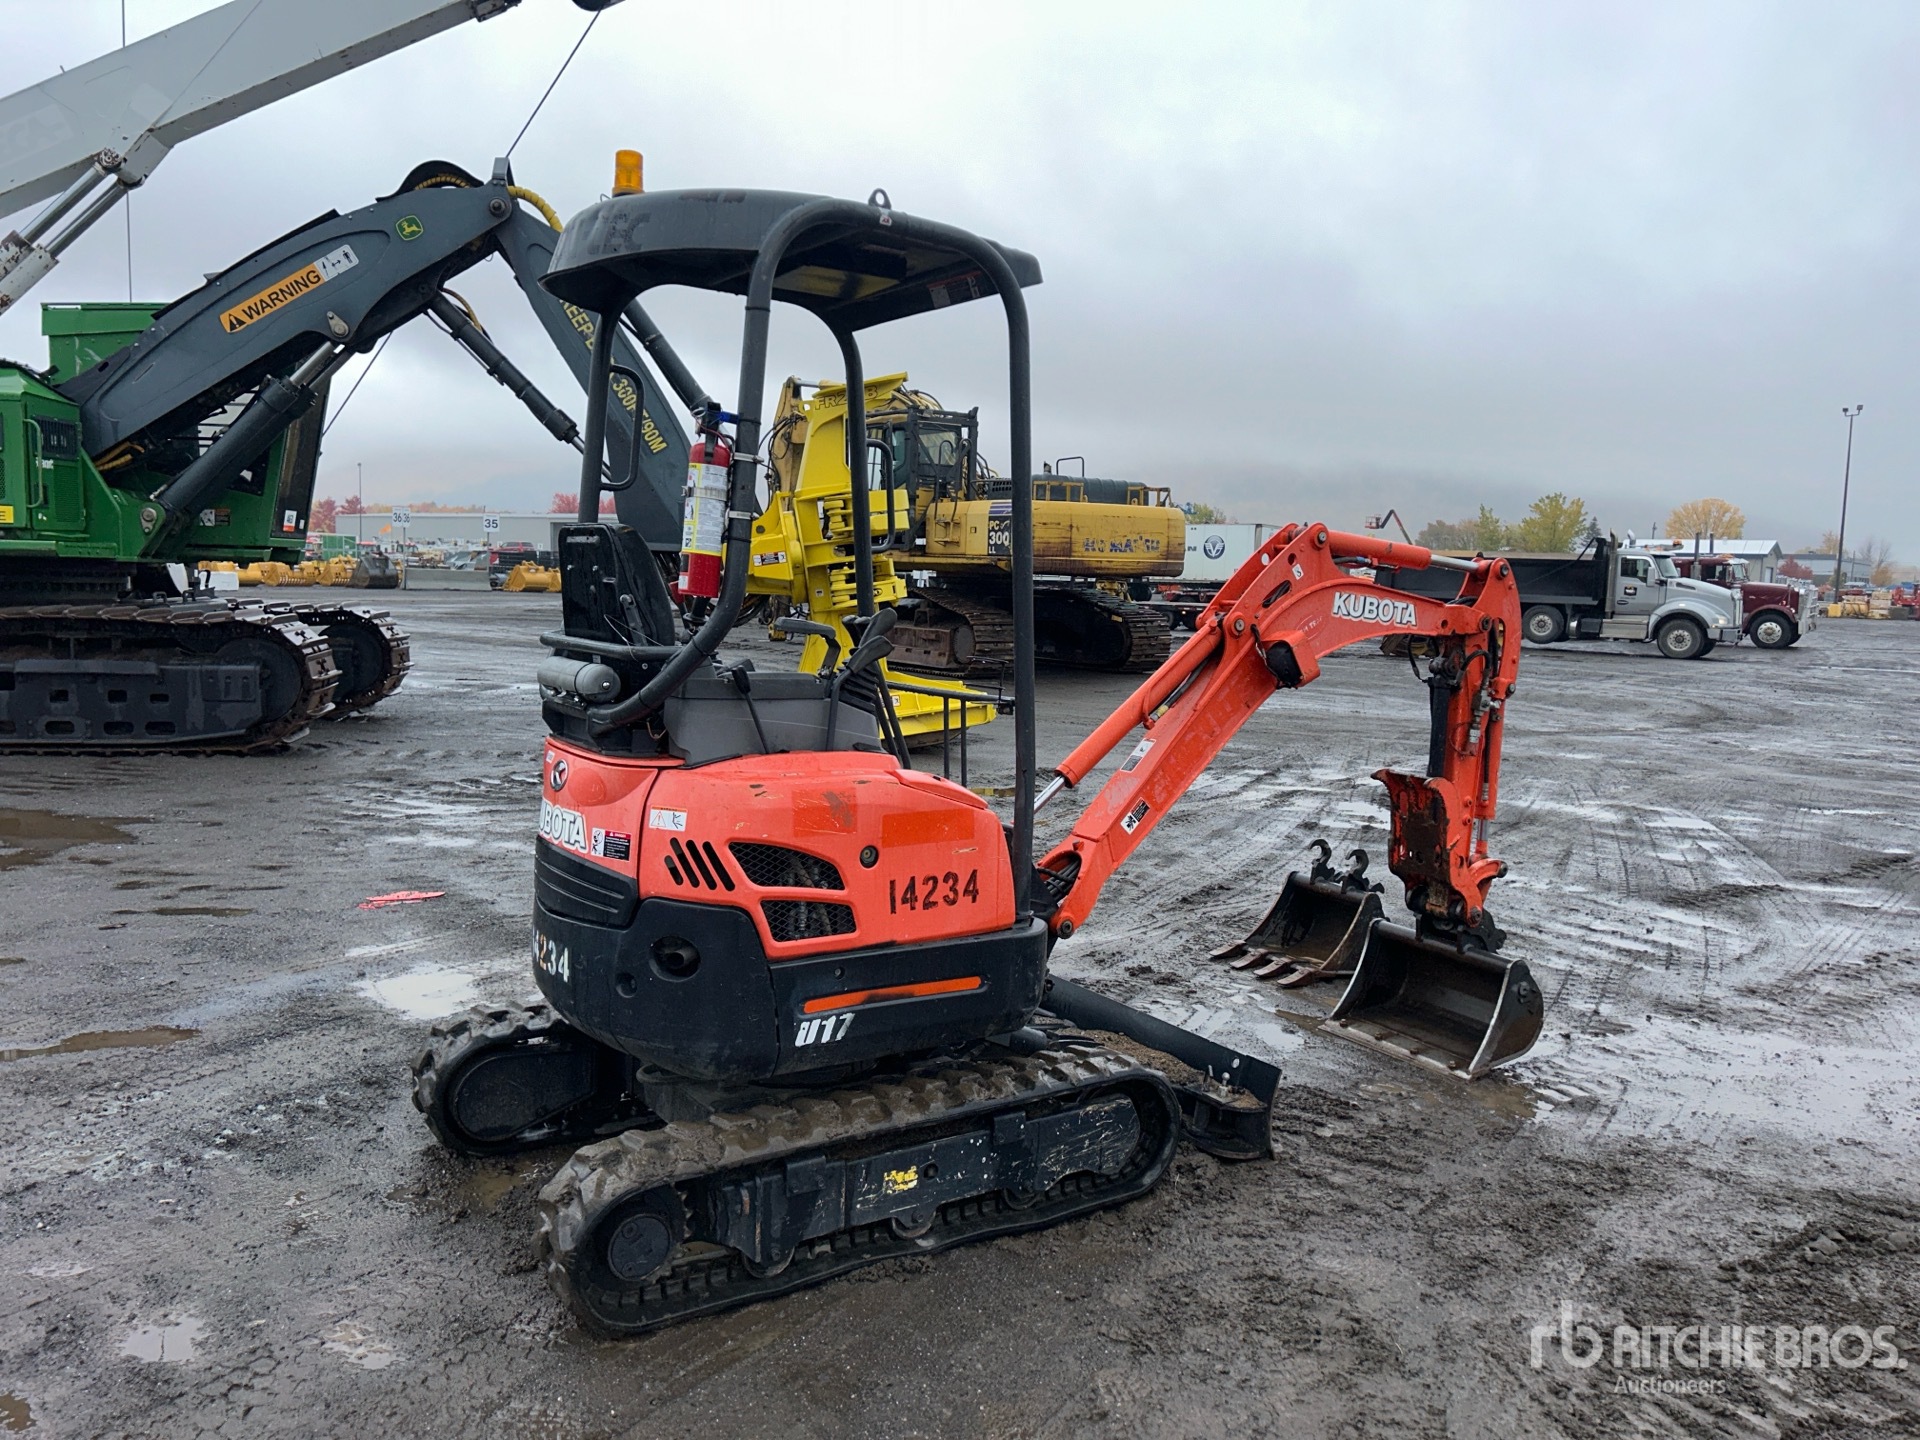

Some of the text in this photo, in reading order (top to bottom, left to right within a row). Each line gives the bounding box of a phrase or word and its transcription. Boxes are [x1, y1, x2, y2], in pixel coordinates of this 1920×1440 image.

[242, 270, 321, 319] WARNING
[815, 385, 878, 410] FR2B
[392, 511, 402, 523] 36
[403, 512, 411, 524] 36
[484, 518, 498, 529] 35
[989, 520, 1000, 530] PC
[1332, 591, 1418, 626] KUBOTA
[889, 869, 979, 915] 14234
[795, 1012, 856, 1047] U17
